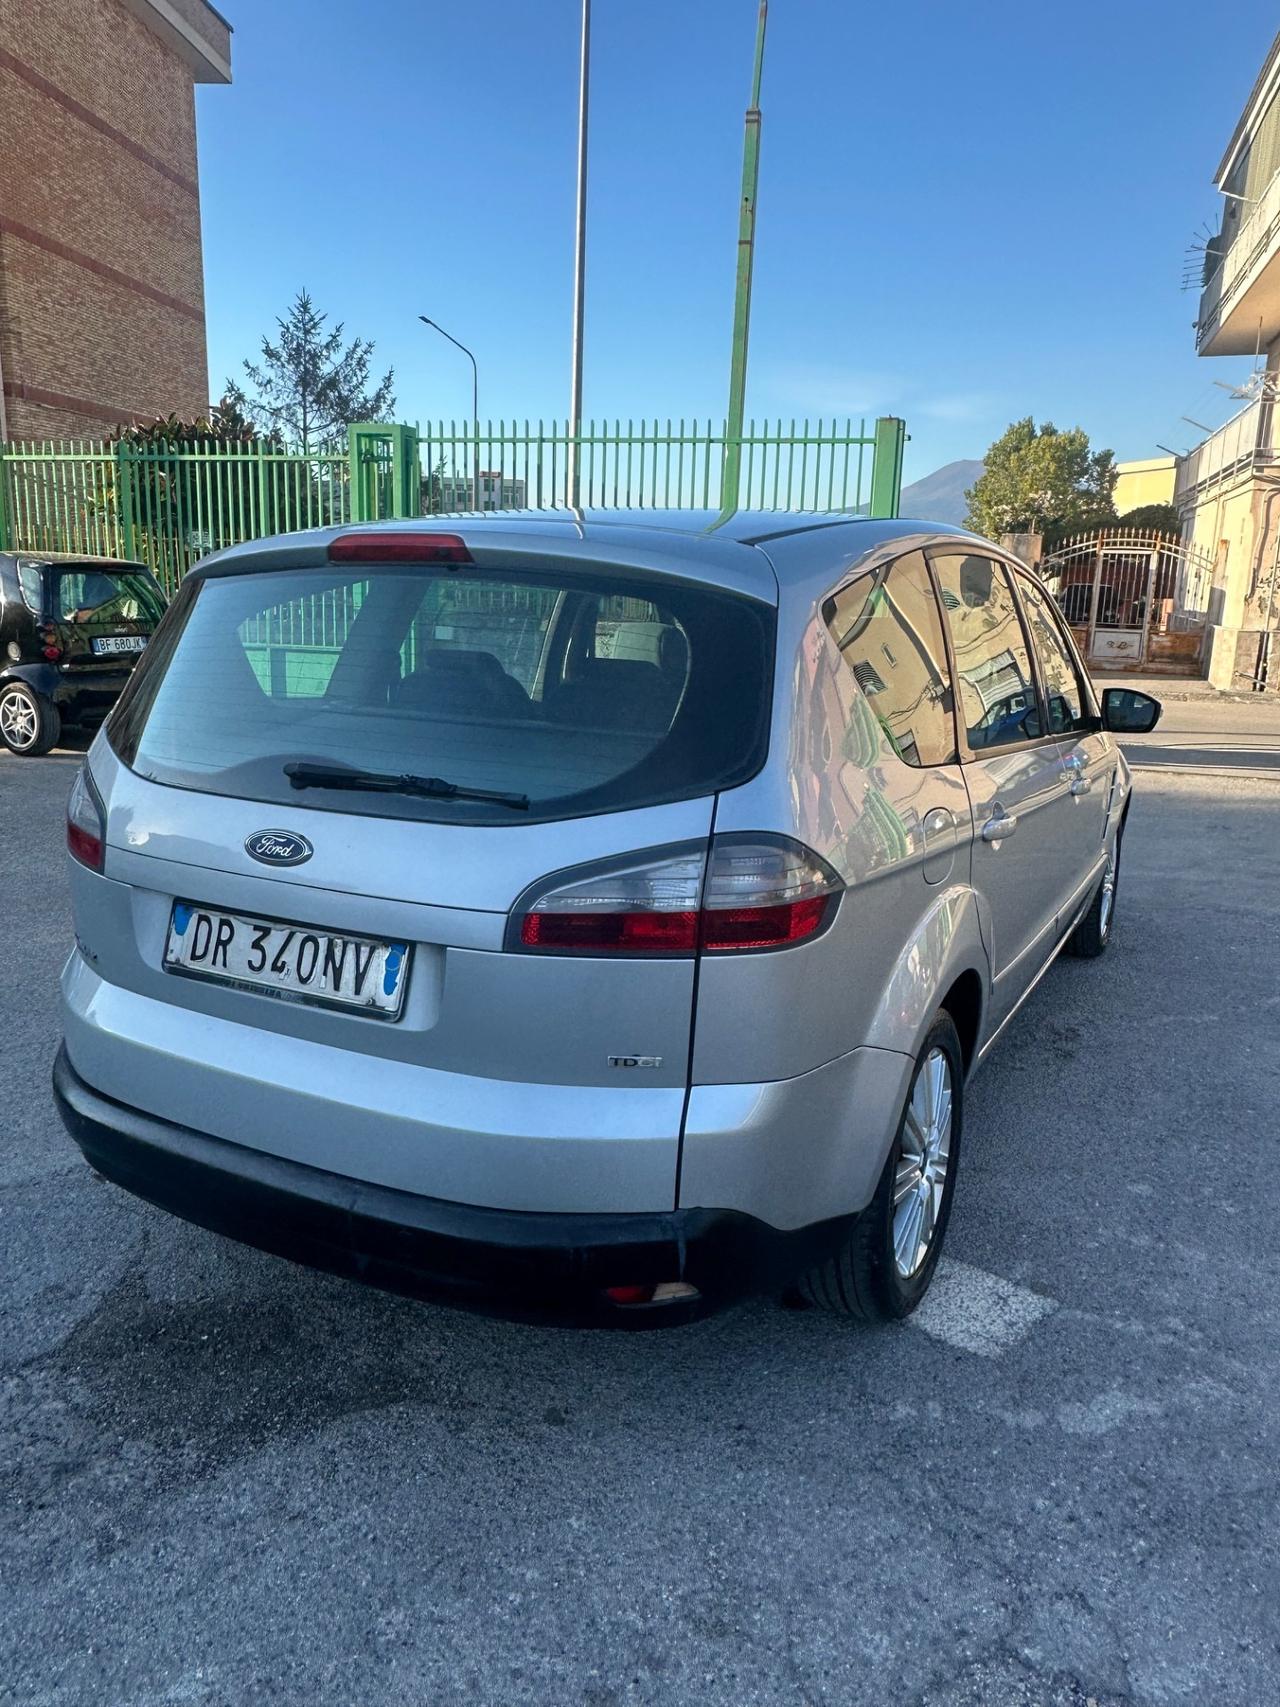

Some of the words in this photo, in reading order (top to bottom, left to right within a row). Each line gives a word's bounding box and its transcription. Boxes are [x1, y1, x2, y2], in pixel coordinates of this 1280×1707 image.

[100, 639, 110, 650] BF
[256, 835, 295, 857] Ford
[190, 913, 235, 969] DR
[247, 924, 376, 996] 340NV
